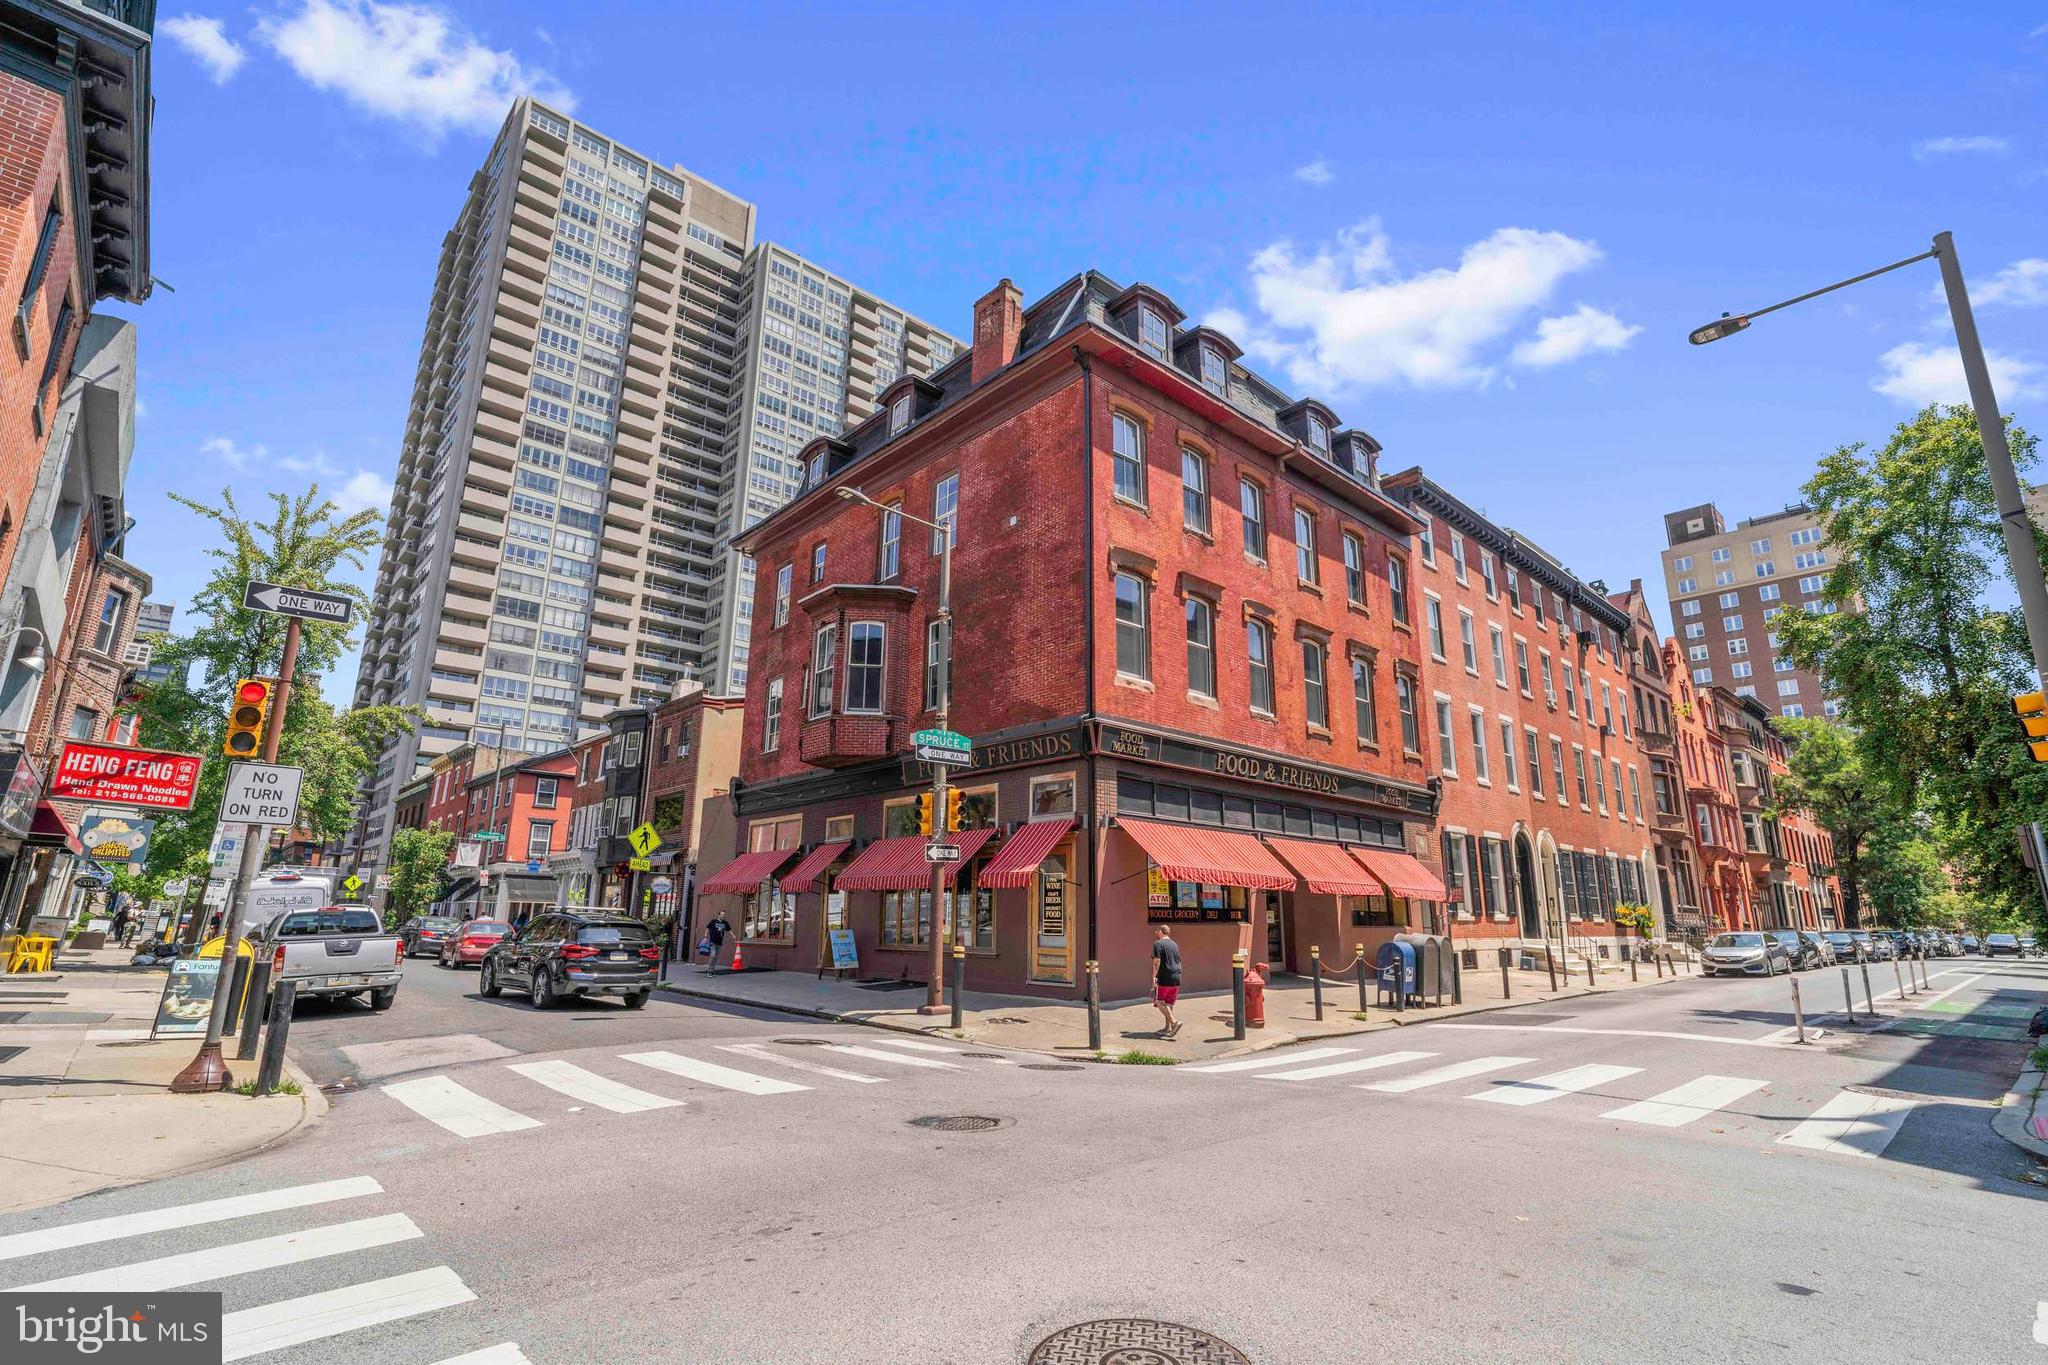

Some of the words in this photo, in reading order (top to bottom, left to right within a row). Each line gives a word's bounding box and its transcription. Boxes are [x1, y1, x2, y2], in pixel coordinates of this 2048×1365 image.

[278, 594, 308, 609] ONE
[313, 600, 340, 613] WAY
[918, 733, 960, 748] SPRUCE
[1120, 731, 1144, 745] FOOD
[930, 749, 946, 758] ONE
[950, 752, 965, 760] WAY
[988, 733, 1072, 766] FRIENDS
[1112, 740, 1150, 758] MARKET
[65, 751, 120, 775] HENG
[124, 758, 174, 781] FENG
[1216, 753, 1260, 777] FOOD
[1265, 763, 1276, 780] &
[1281, 766, 1339, 793] FRIENDS
[252, 771, 278, 784] NO
[60, 775, 94, 787] Hand
[98, 779, 138, 792] Drawn
[142, 784, 189, 797] Noodles
[71, 787, 91, 796] Tel:
[244, 787, 283, 801] TURN
[229, 803, 251, 815] ON
[258, 805, 289, 818] RED
[91, 848, 131, 857] UNLIMITED
[1174, 910, 1199, 919] GROCERY
